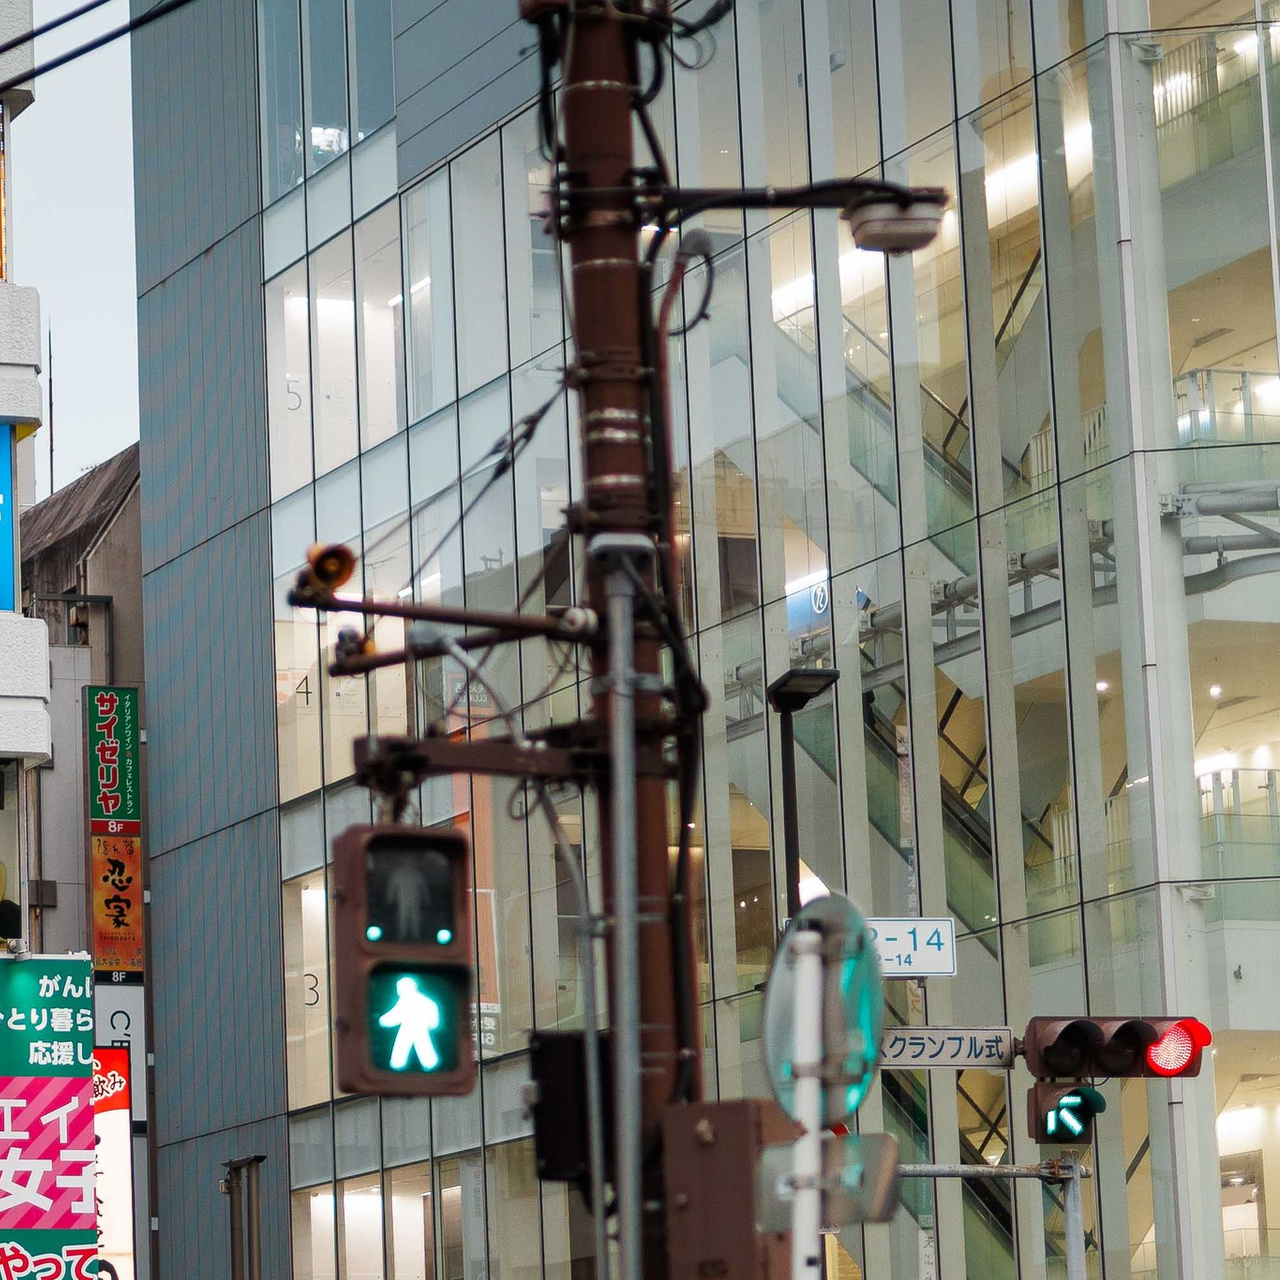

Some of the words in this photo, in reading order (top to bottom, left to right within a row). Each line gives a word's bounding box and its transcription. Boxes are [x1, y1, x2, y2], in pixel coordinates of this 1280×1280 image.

[95, 692, 121, 815] サイゼリヤ
[108, 821, 124, 833] 8F
[112, 972, 127, 982] 8F
[28, 1041, 93, 1066] 応援し
